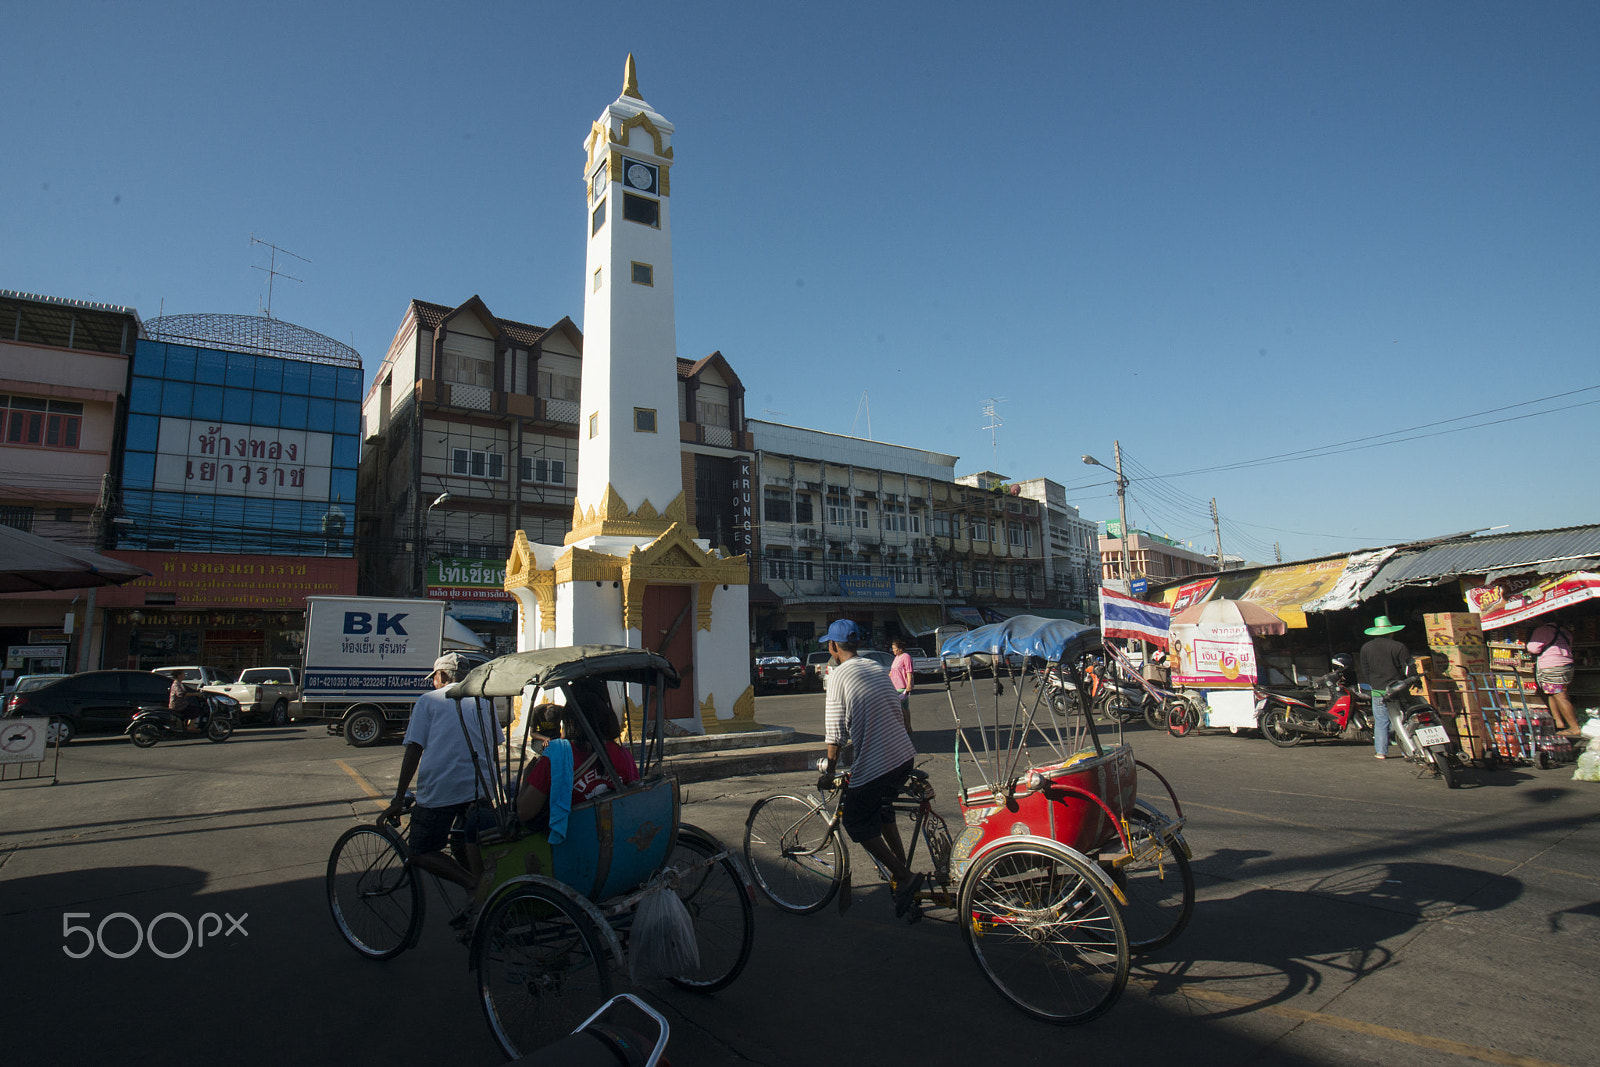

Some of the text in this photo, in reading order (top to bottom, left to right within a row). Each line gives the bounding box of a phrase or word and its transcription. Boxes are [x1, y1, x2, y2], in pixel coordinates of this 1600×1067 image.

[198, 426, 298, 461] ห้างทอง
[186, 461, 305, 488] เยาวราช
[162, 557, 306, 576] ห้างทองเยาวราช
[473, 589, 509, 598] อาหารสัตว
[343, 611, 410, 635] BK
[341, 637, 410, 660] ห้องเย็น สุรินทร์
